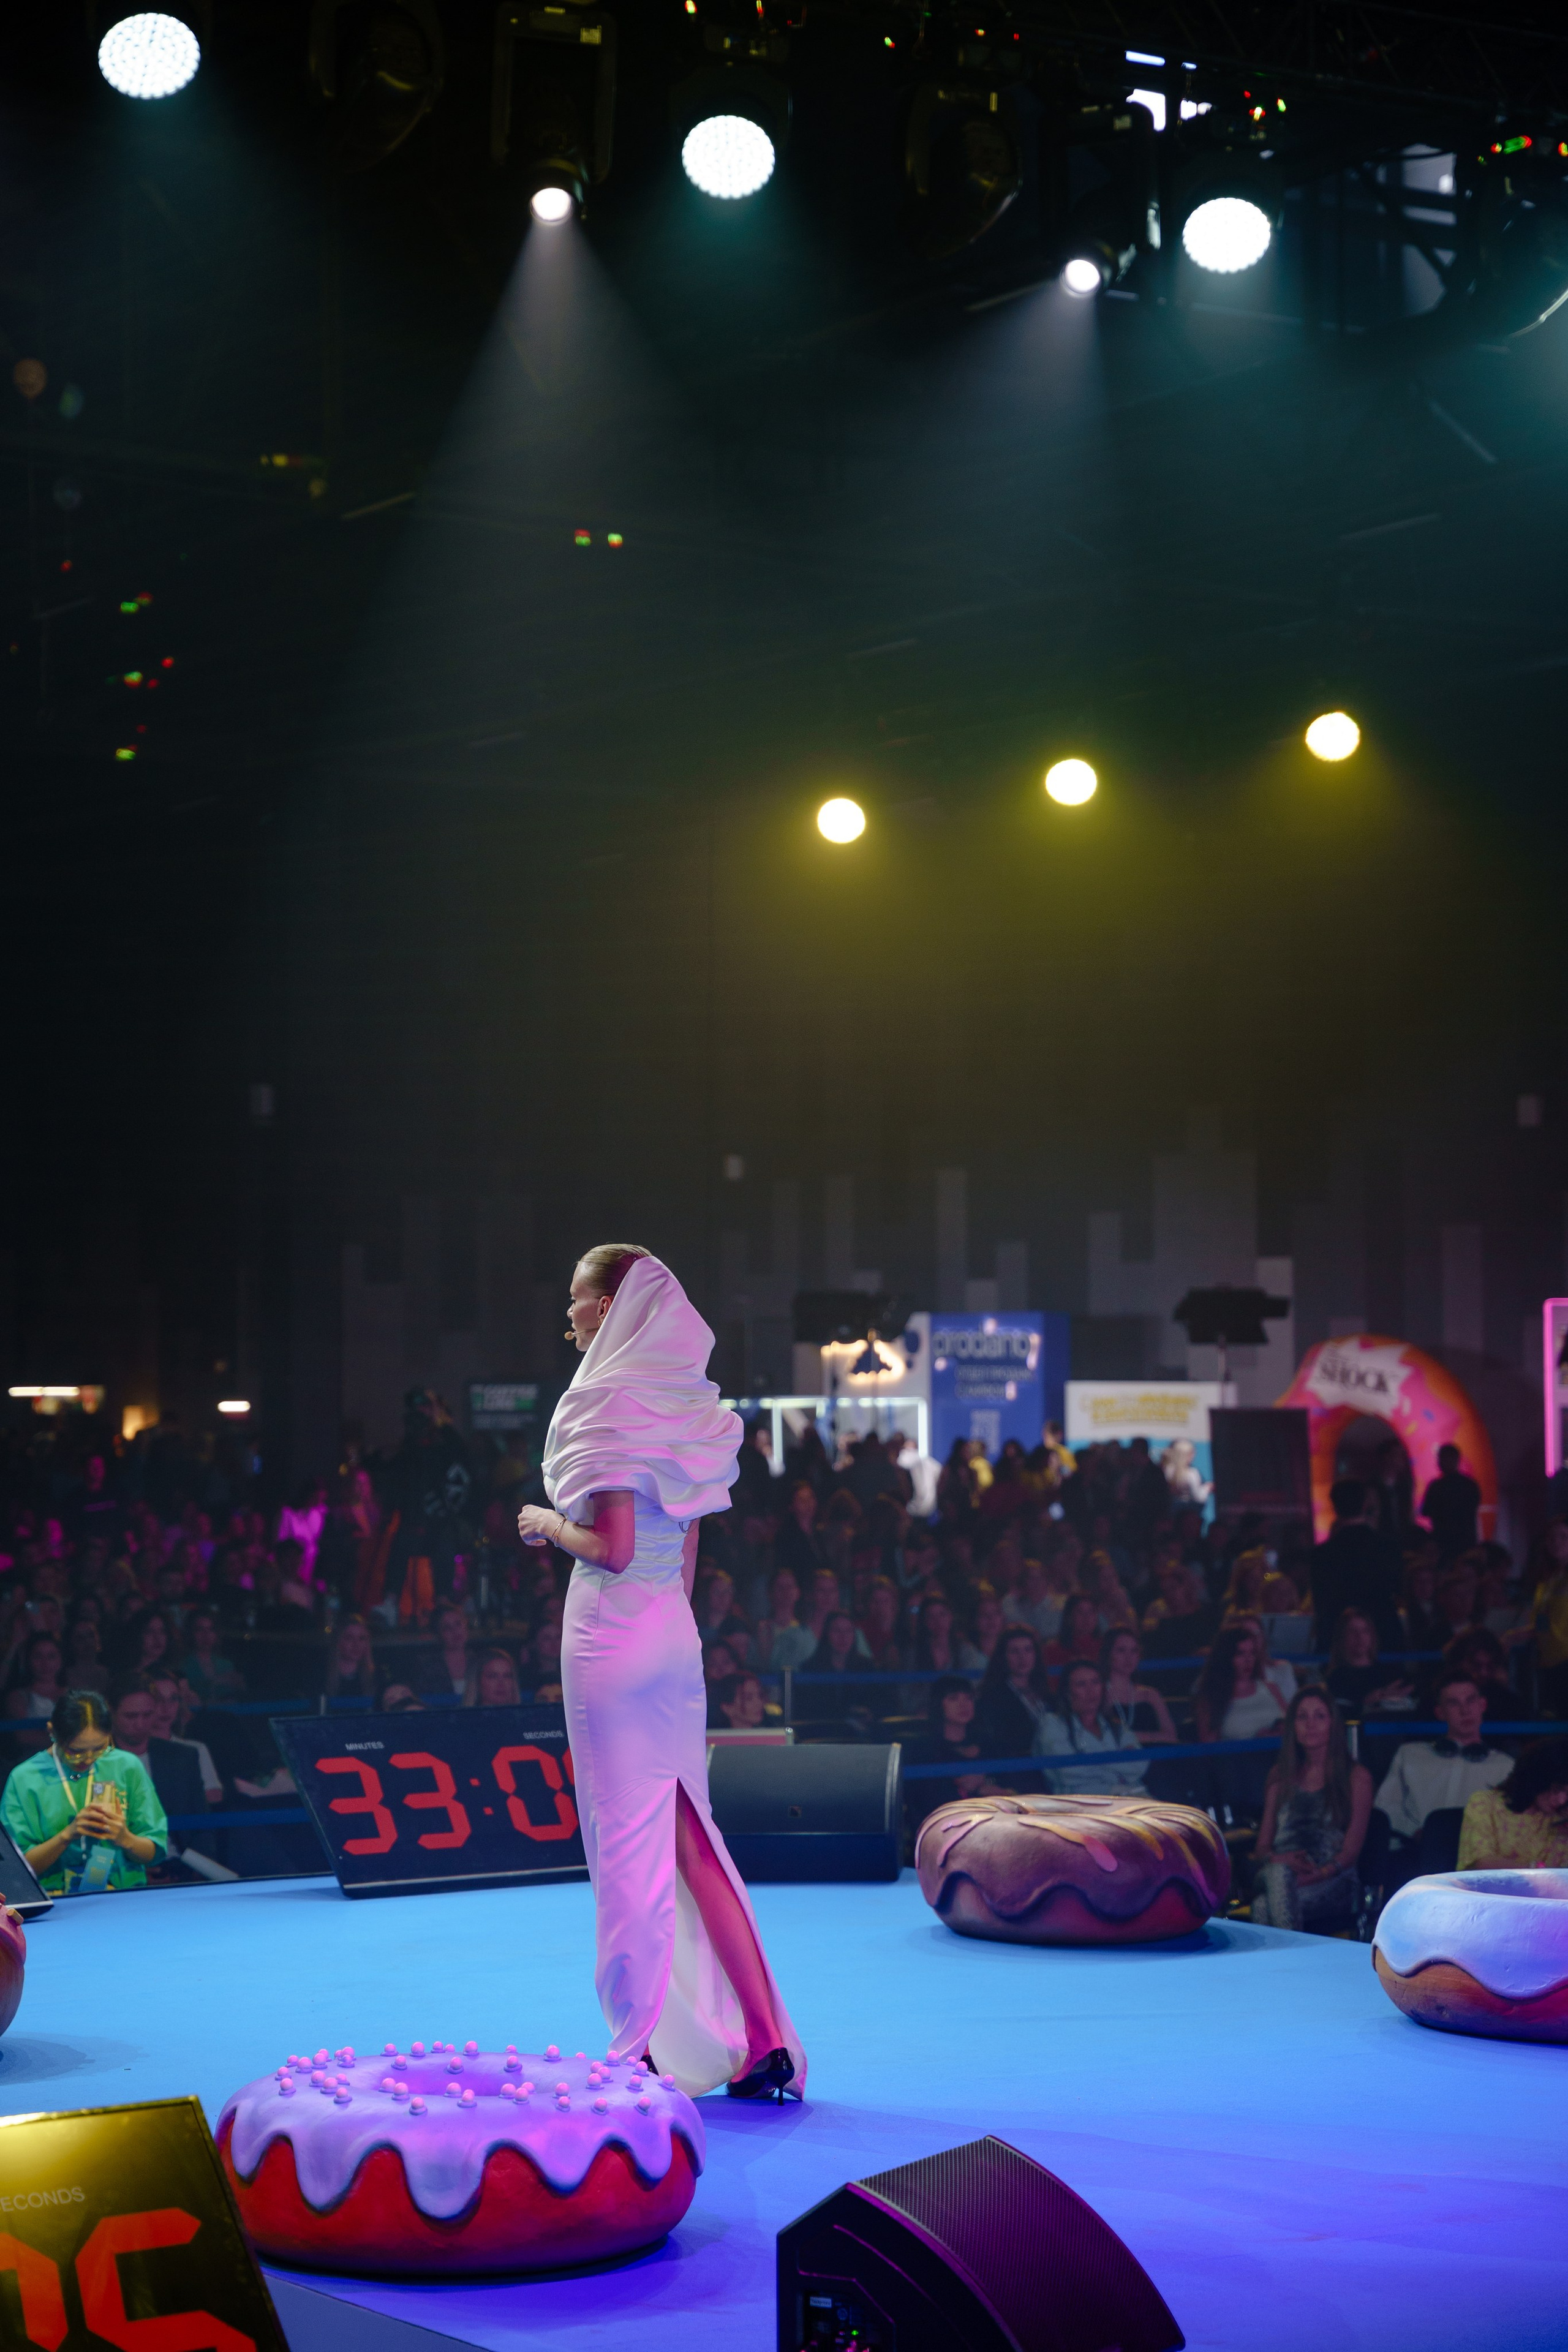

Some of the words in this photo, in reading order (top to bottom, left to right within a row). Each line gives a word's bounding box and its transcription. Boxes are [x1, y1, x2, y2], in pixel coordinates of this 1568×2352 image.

[522, 1730, 564, 1740] SECONDS
[345, 1741, 385, 1751] MINUTES
[315, 1745, 579, 1855] 33:0
[0, 2186, 85, 2212] ECONDS
